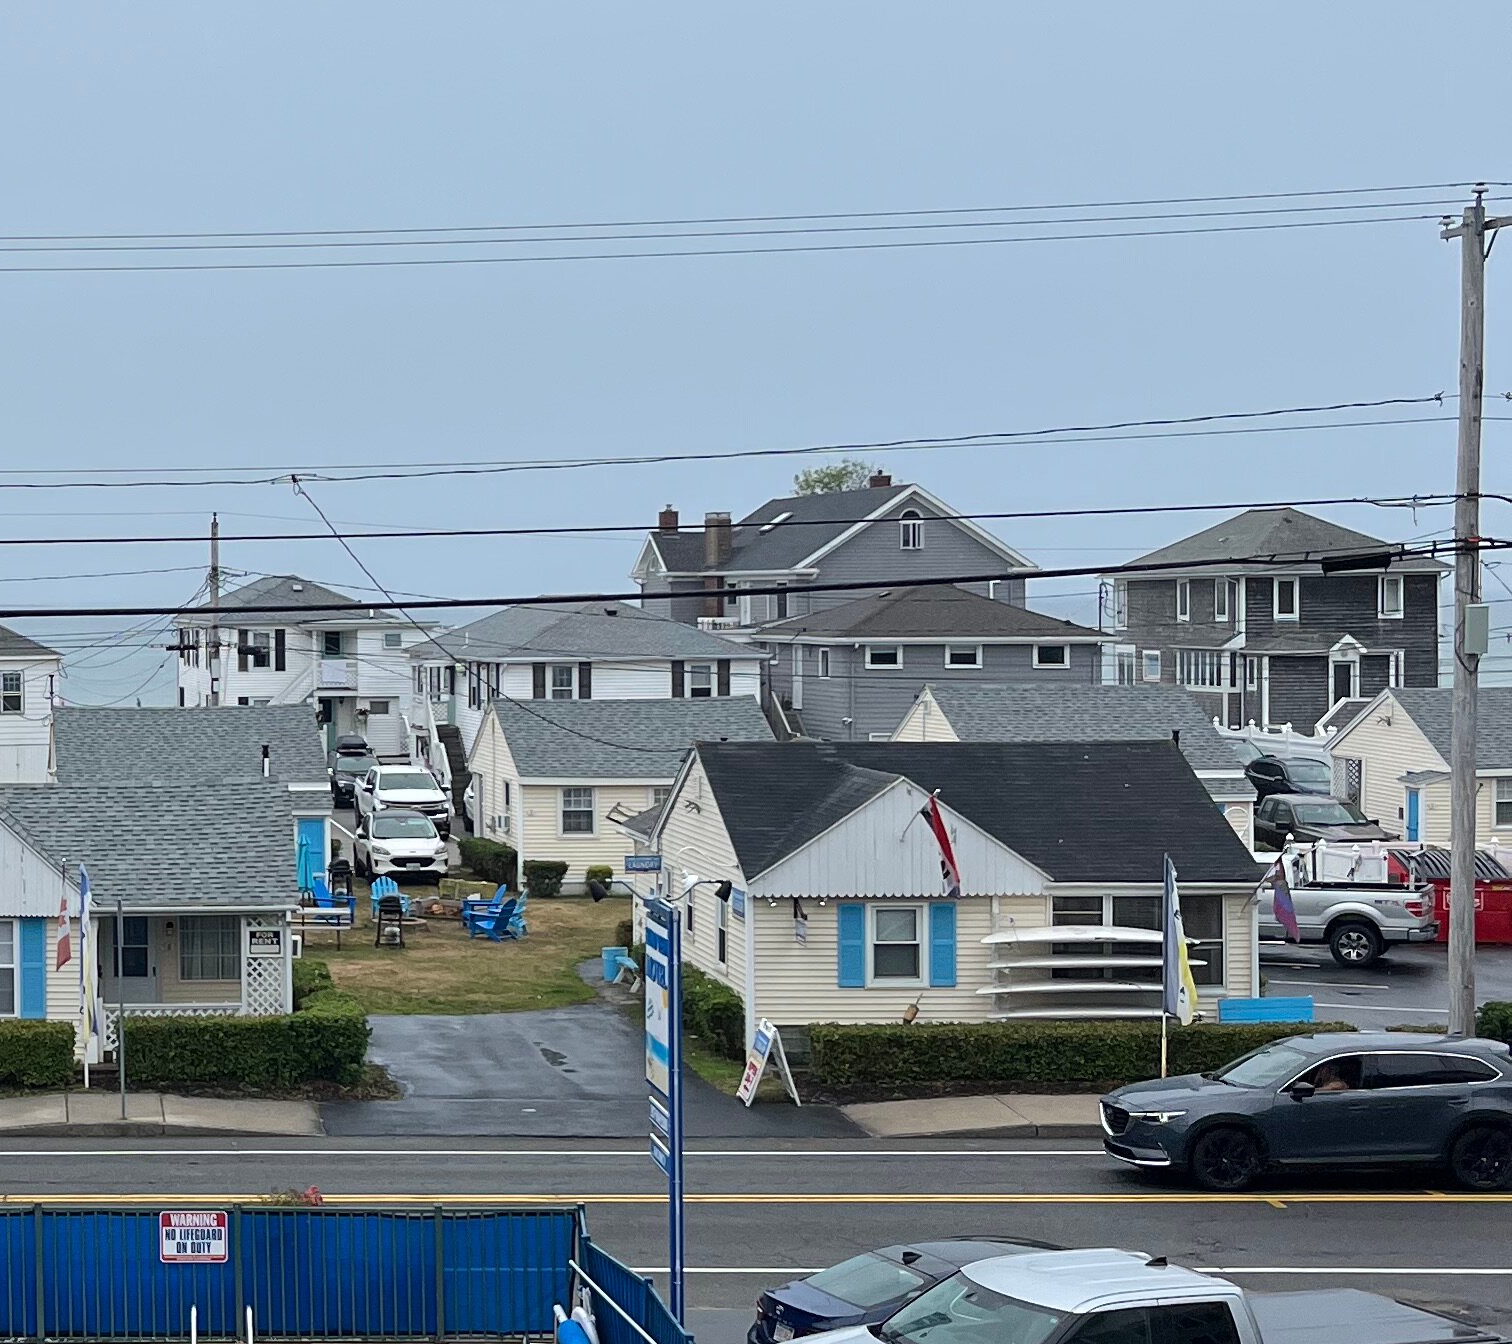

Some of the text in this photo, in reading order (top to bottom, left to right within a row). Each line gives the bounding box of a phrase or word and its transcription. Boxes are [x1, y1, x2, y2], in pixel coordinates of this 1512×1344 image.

[170, 1213, 217, 1226] WARNING
[165, 1229, 222, 1240] NO LIFEGUARD
[176, 1242, 211, 1253] ON DUTY
